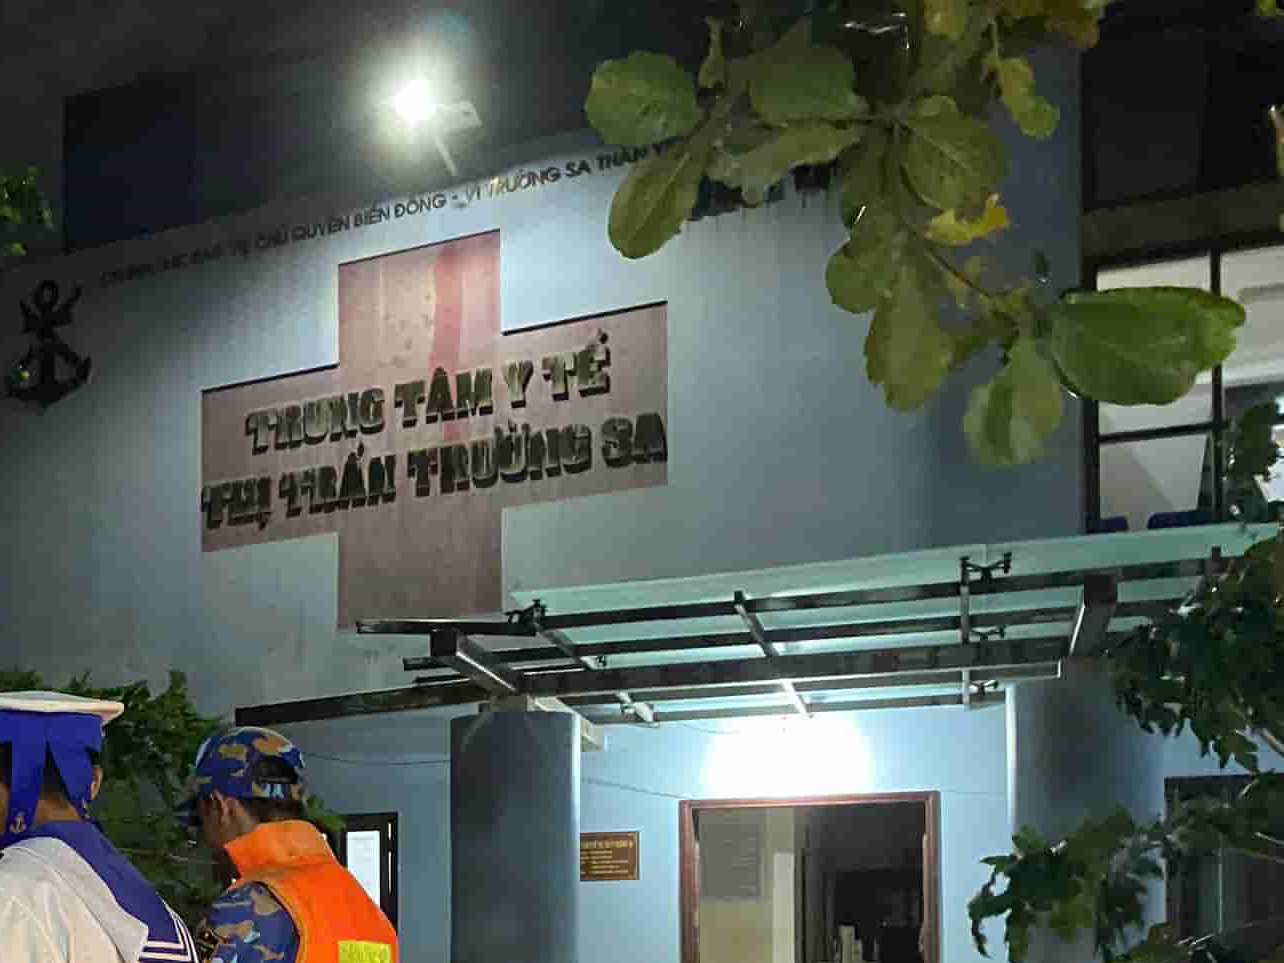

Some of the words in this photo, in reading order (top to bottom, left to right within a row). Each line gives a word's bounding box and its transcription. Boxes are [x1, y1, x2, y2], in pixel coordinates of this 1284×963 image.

[565, 159, 592, 178] SA
[244, 388, 385, 455] TRUNG
[393, 365, 493, 428] TÂM
[502, 359, 534, 408] Y
[542, 328, 611, 398] TẾ
[201, 476, 272, 531] THỊ
[279, 441, 397, 518] TRẤN
[406, 419, 594, 498] TRƯỜNG
[601, 412, 669, 469] SA
